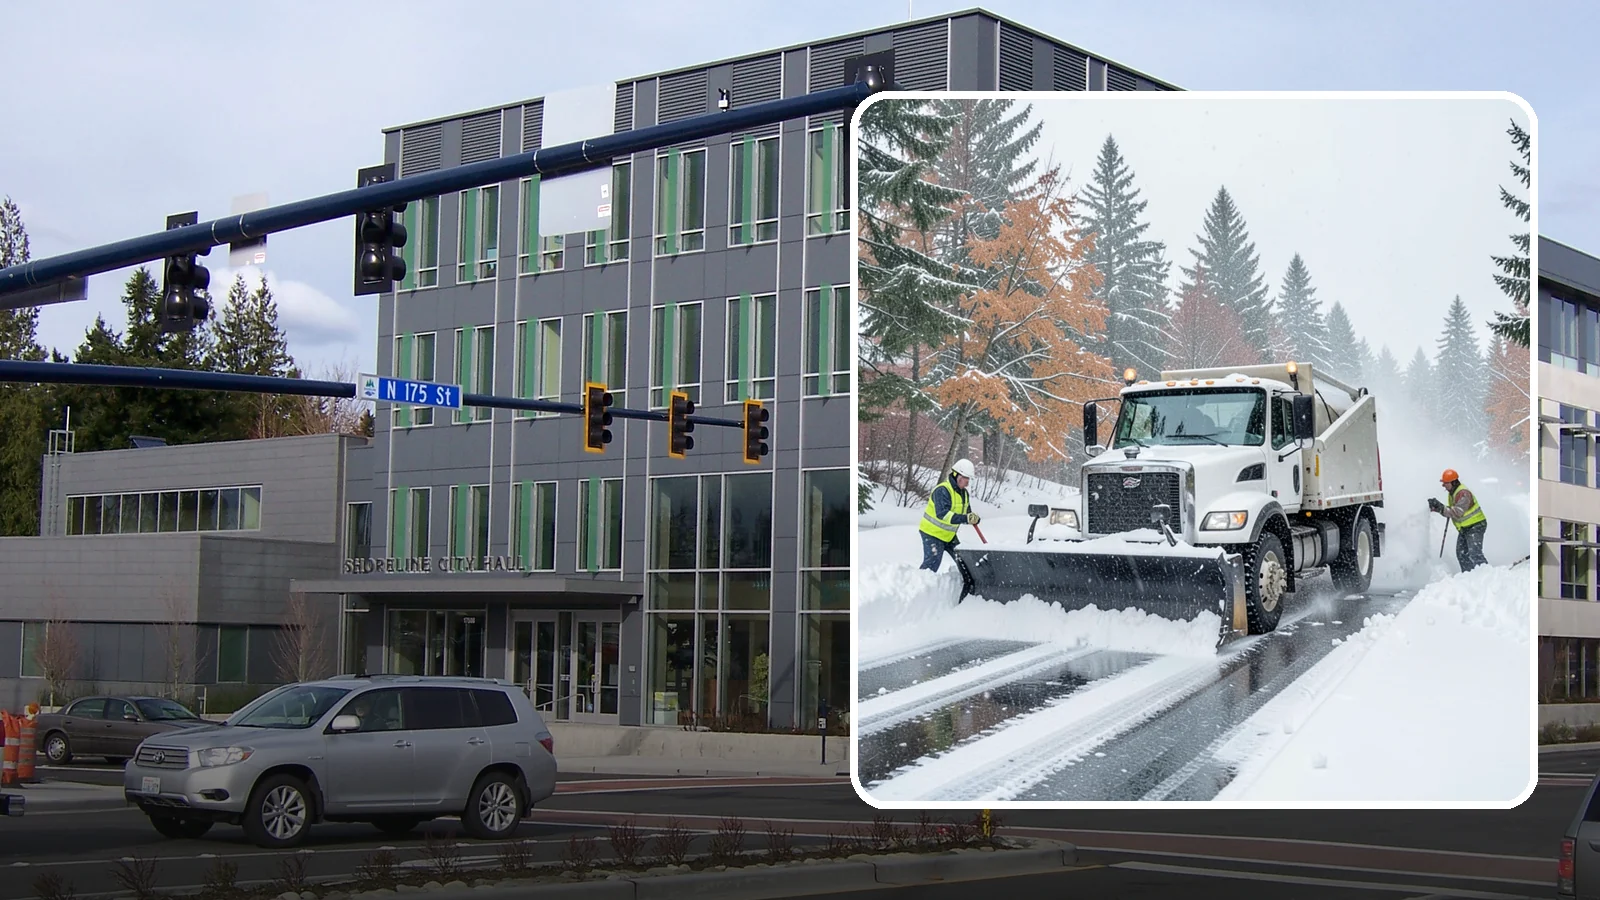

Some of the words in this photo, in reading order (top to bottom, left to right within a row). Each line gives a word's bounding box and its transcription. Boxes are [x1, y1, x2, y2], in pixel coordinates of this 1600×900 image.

[387, 380, 396, 399] N
[405, 382, 427, 403] 175
[436, 386, 451, 406] St
[344, 557, 431, 573] SHORELINE
[438, 557, 475, 572] CITY
[484, 556, 525, 571] HALL
